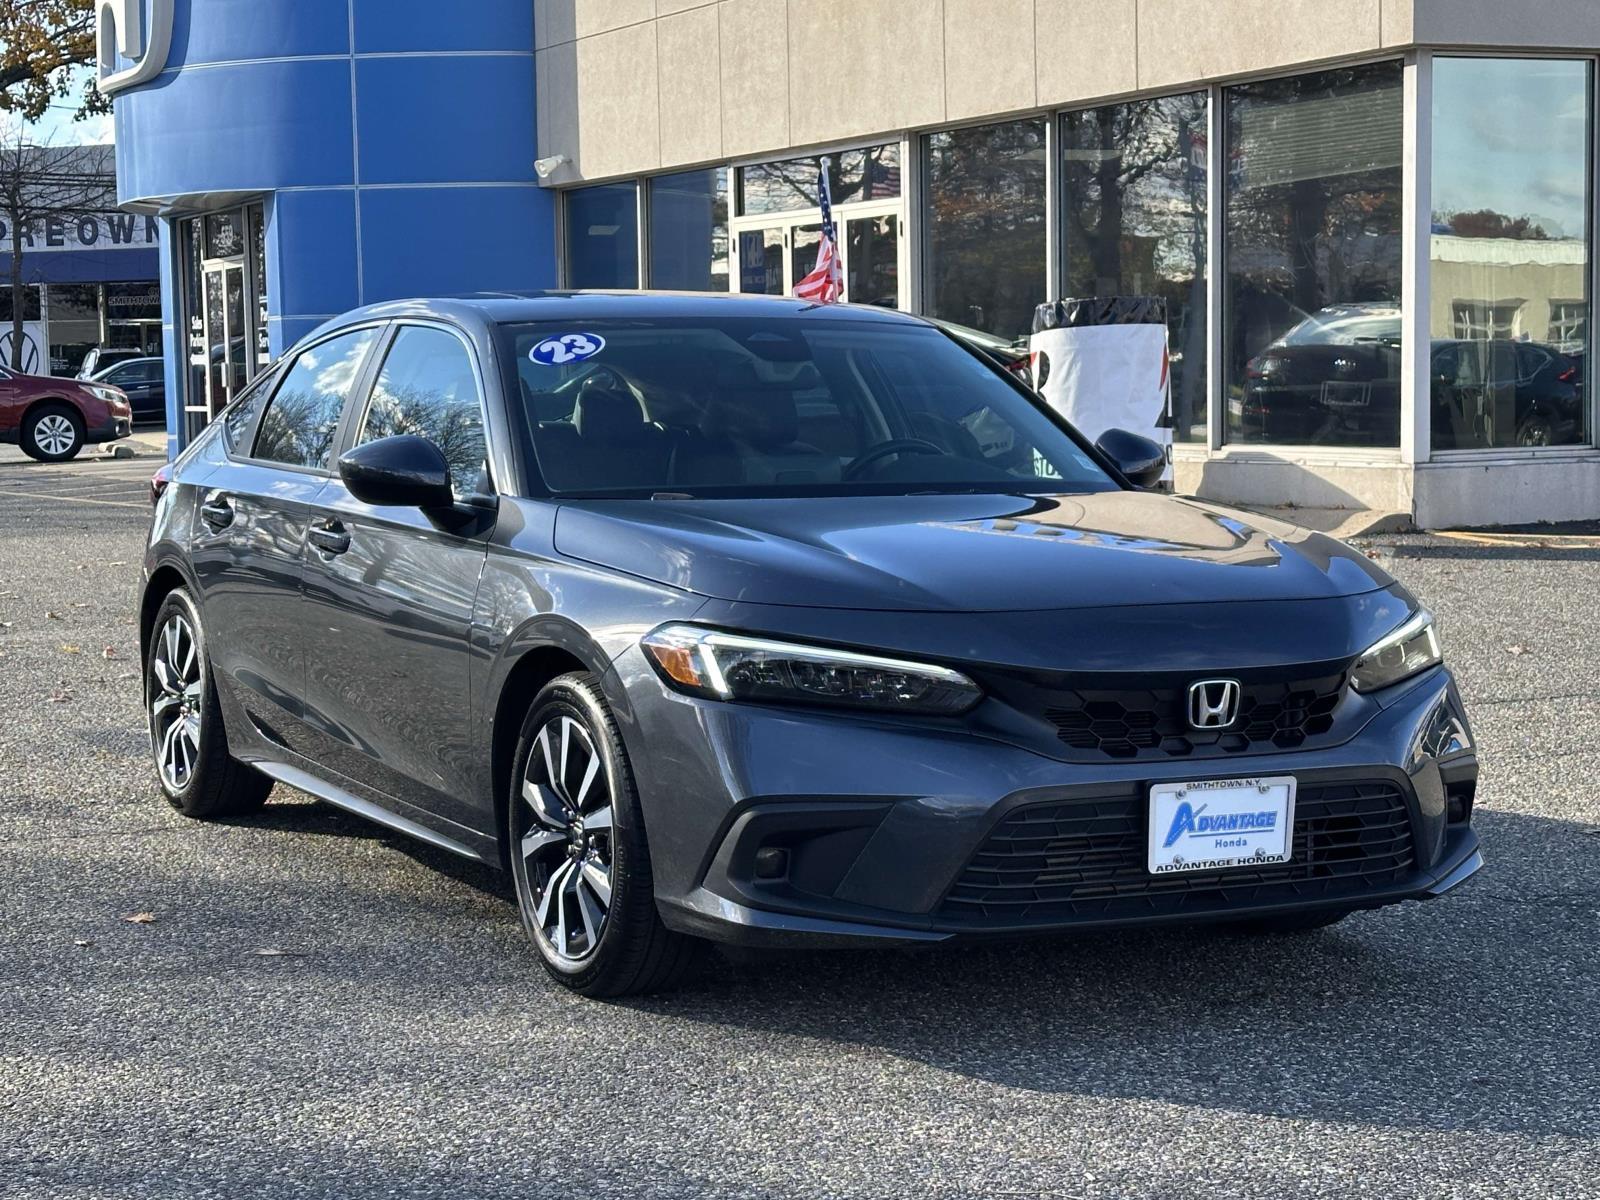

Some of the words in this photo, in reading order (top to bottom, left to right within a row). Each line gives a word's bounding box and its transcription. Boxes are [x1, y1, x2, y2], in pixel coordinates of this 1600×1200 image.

[539, 334, 597, 363] 23
[1162, 801, 1278, 848] ADVANTAGE
[1215, 838, 1248, 848] Honda
[1156, 858, 1235, 872] ADVANTAGE
[1237, 854, 1285, 865] HONDA
